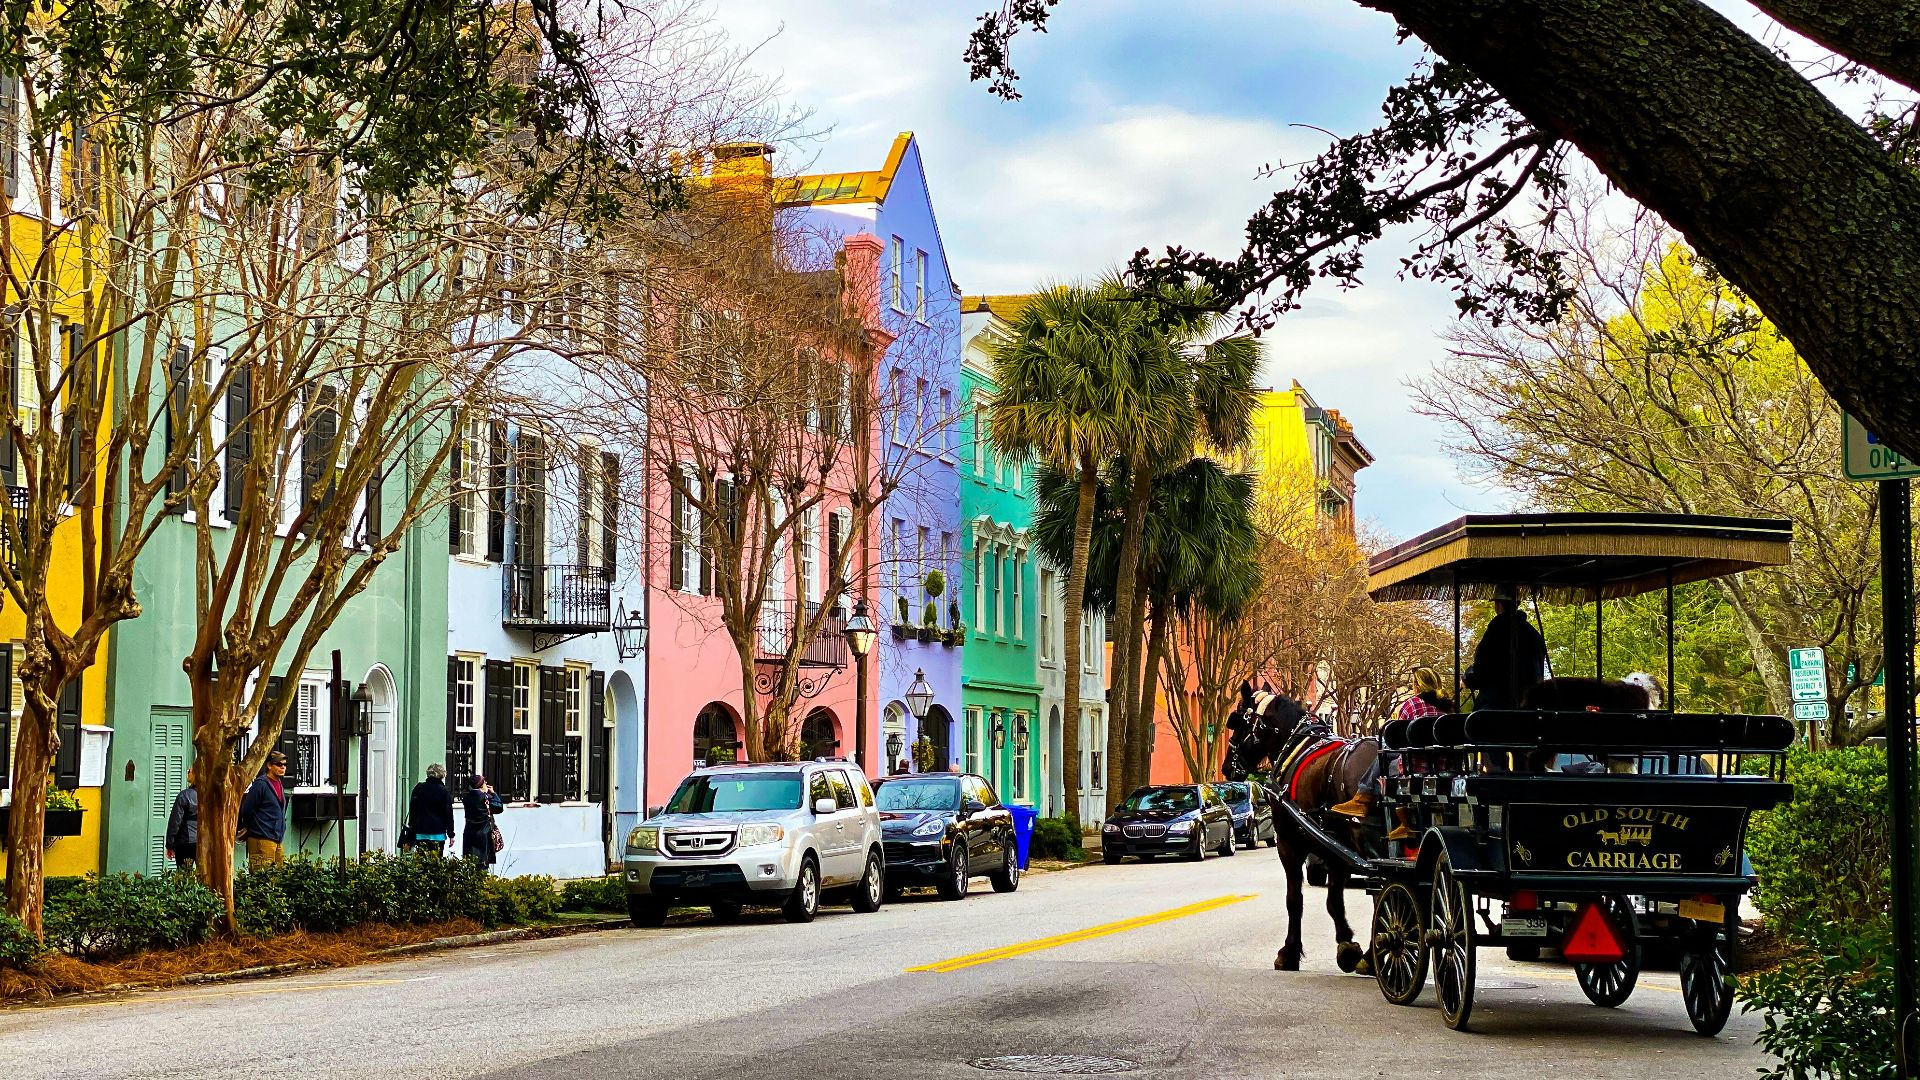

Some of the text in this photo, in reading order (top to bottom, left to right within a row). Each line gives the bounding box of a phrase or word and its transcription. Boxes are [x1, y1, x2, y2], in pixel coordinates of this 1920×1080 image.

[1869, 448, 1907, 469] ONL
[1793, 653, 1799, 667] 1
[1795, 669, 1820, 677] RESIDENTIAL
[1563, 807, 1690, 830] OLD SOUTH
[1566, 851, 1682, 869] CARRIAGE
